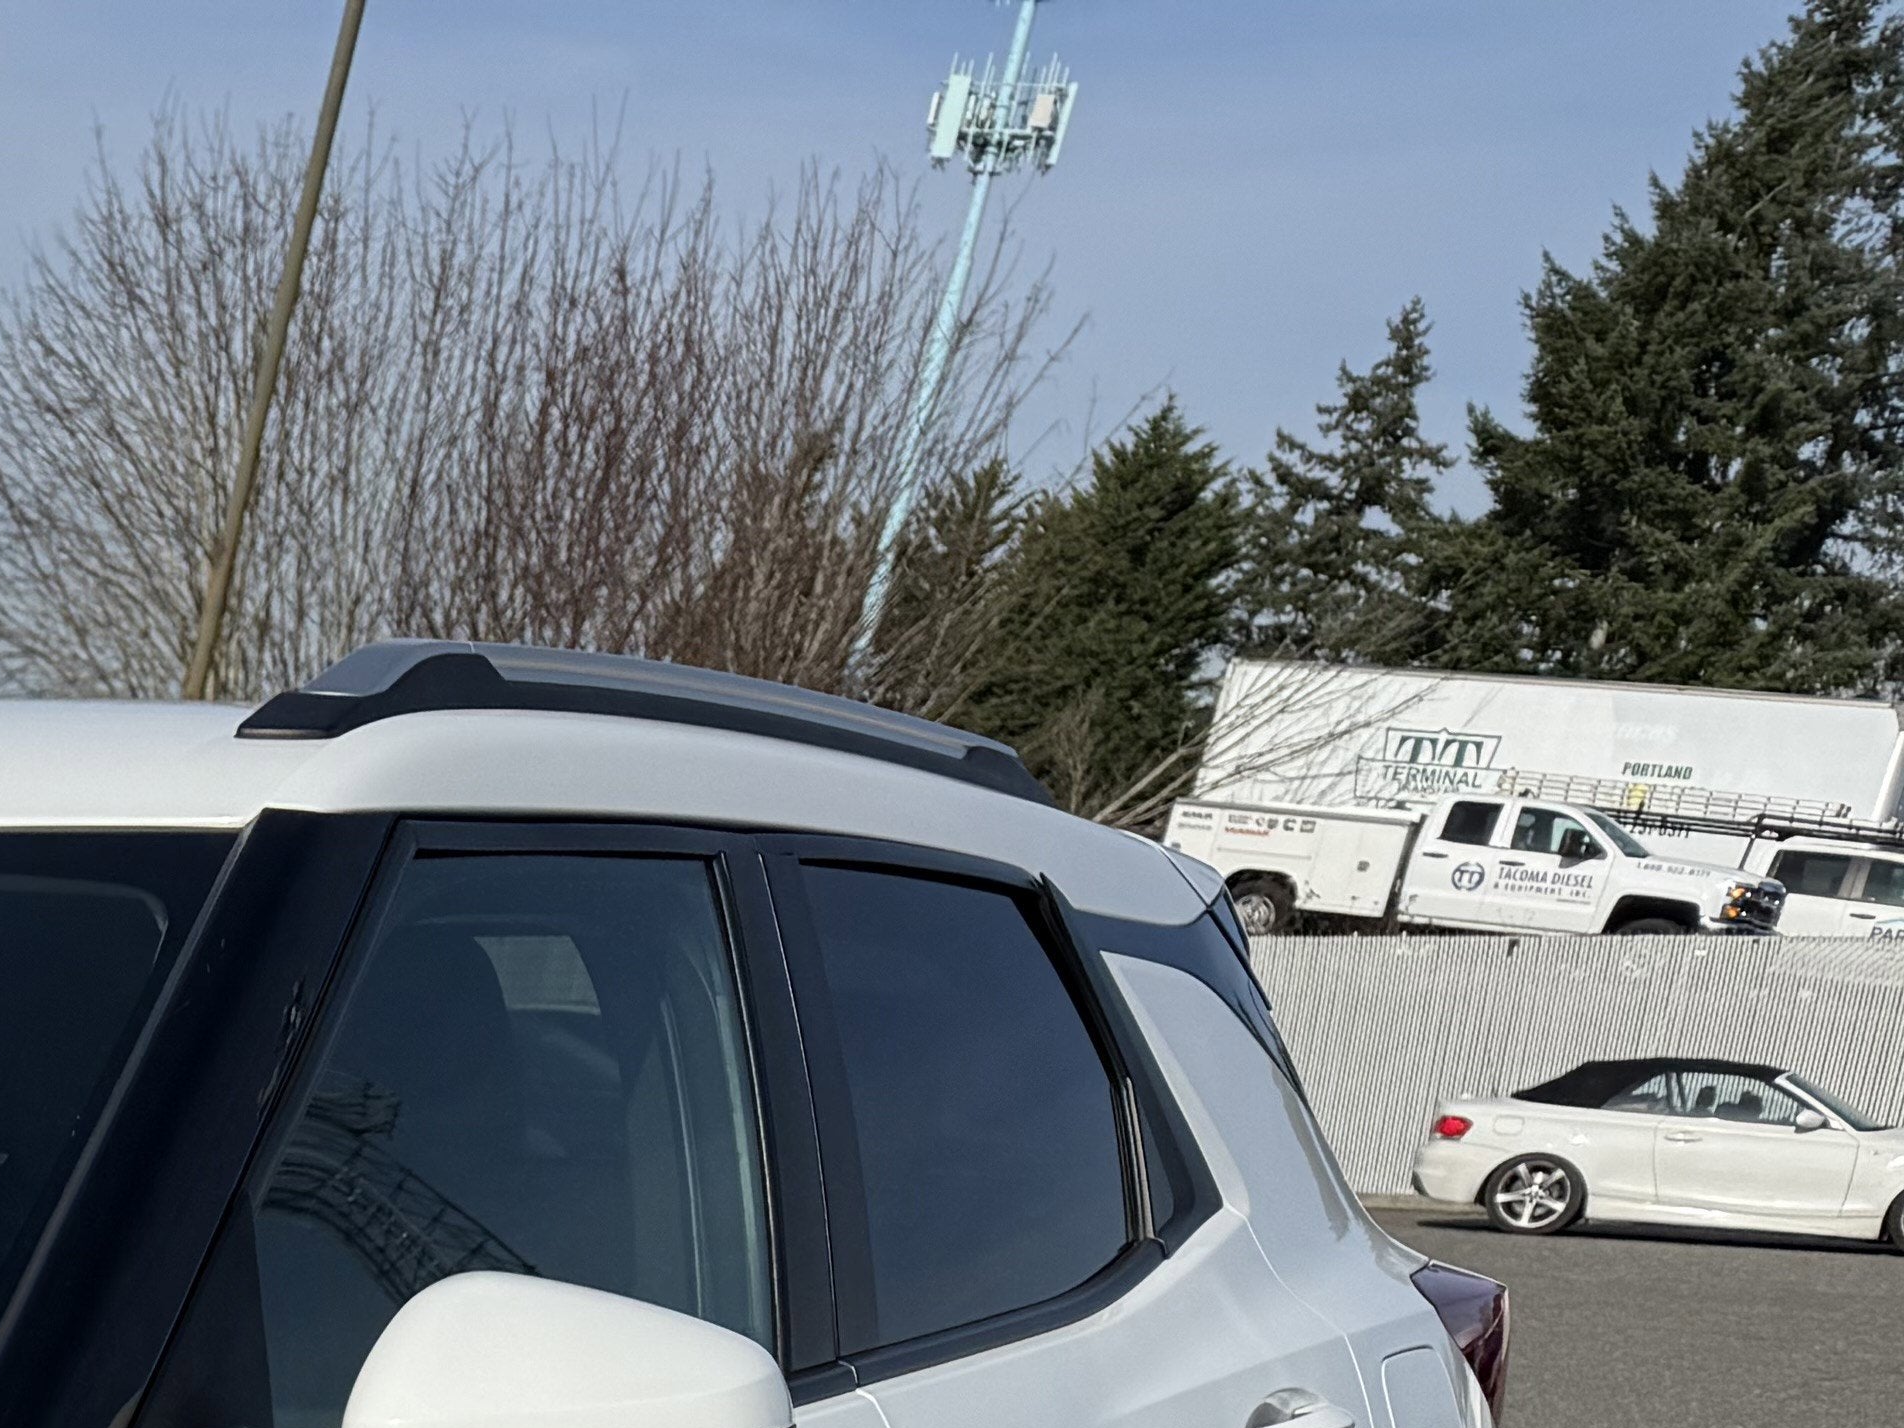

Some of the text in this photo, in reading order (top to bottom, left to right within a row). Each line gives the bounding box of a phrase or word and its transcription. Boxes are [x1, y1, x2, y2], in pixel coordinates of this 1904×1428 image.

[1395, 735, 1484, 767] TT
[1382, 764, 1482, 790] TERMINAL
[1621, 761, 1693, 780] PORTLAND
[1498, 866, 1593, 889] TACOMA DIESEL
